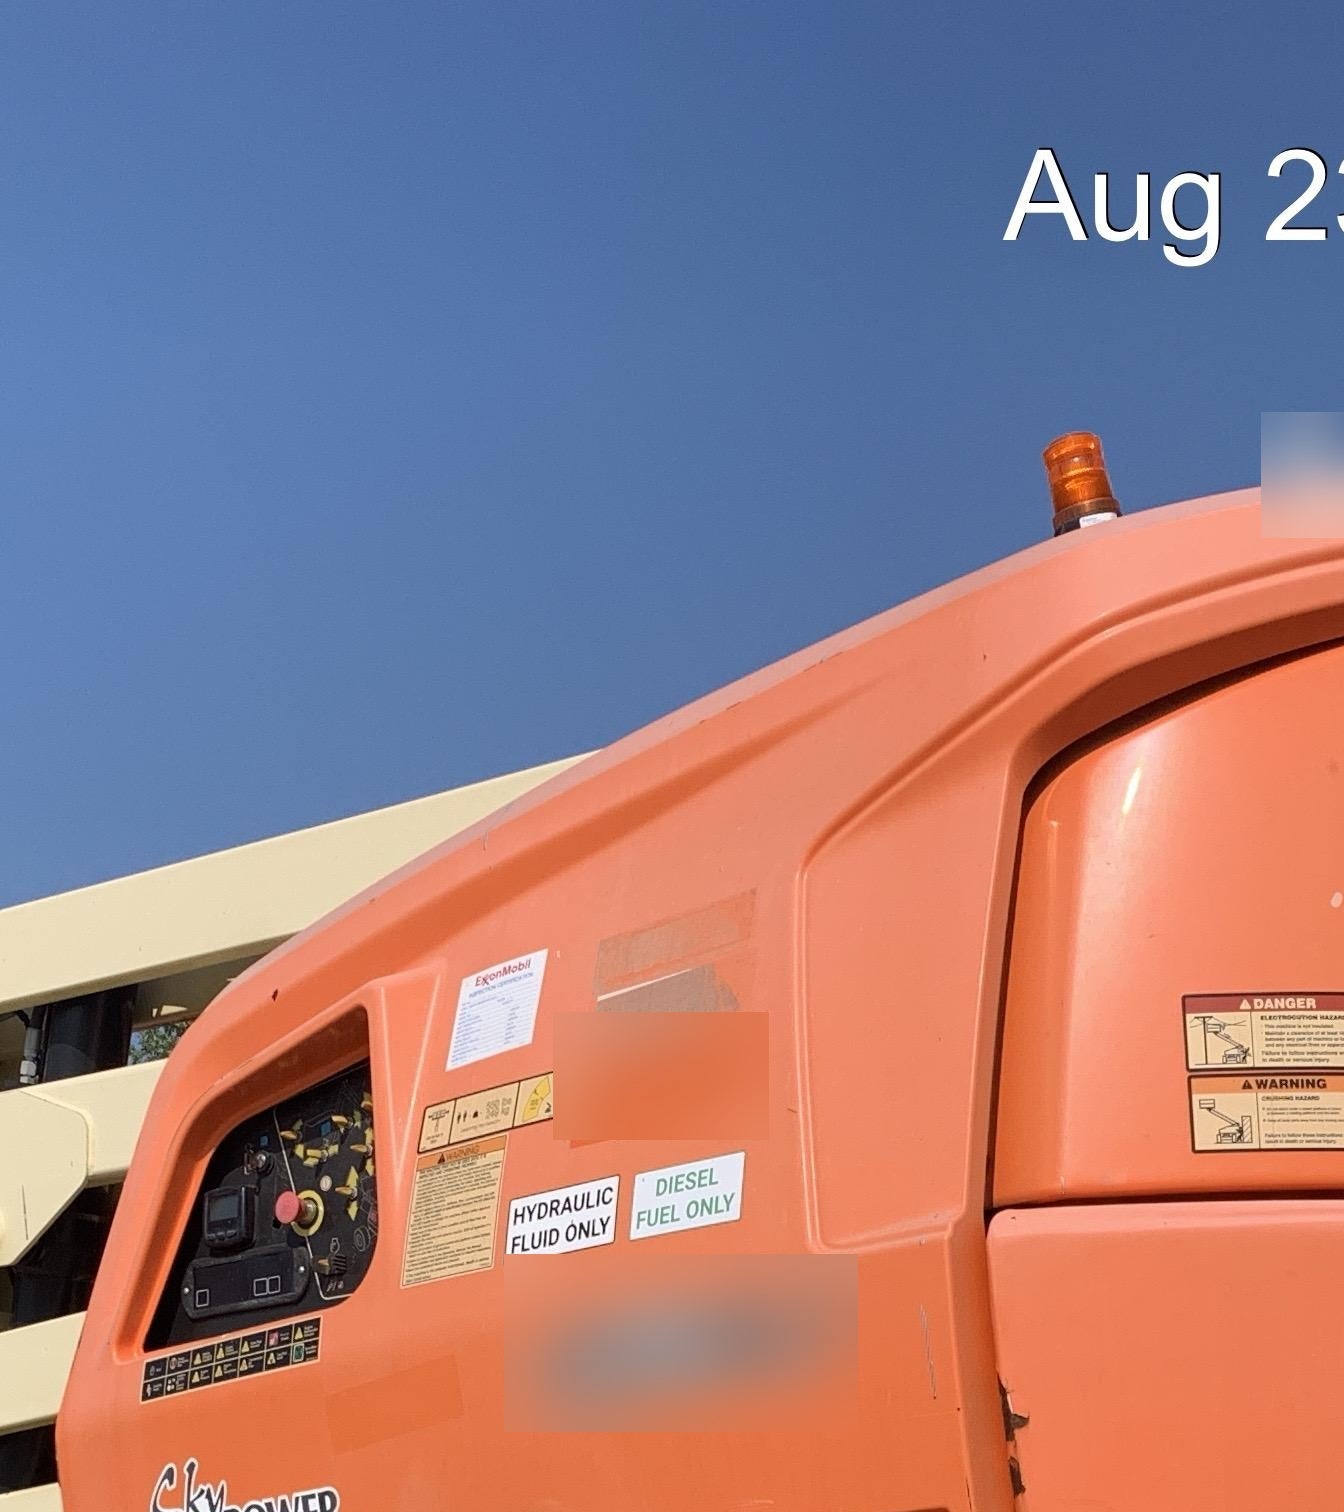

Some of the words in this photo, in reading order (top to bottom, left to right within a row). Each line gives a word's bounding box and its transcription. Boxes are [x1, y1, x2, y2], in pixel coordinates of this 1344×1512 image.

[475, 958, 531, 987] ExxonMobil
[1253, 997, 1317, 1010] DANGER
[1255, 1078, 1328, 1090] WARNING
[656, 1167, 719, 1197] DIESEL
[513, 1186, 614, 1226] HYDRAULIC
[636, 1206, 681, 1230] FUEL
[686, 1193, 735, 1220] ONLY
[511, 1227, 560, 1254] FLUID
[565, 1215, 611, 1244] ONLY
